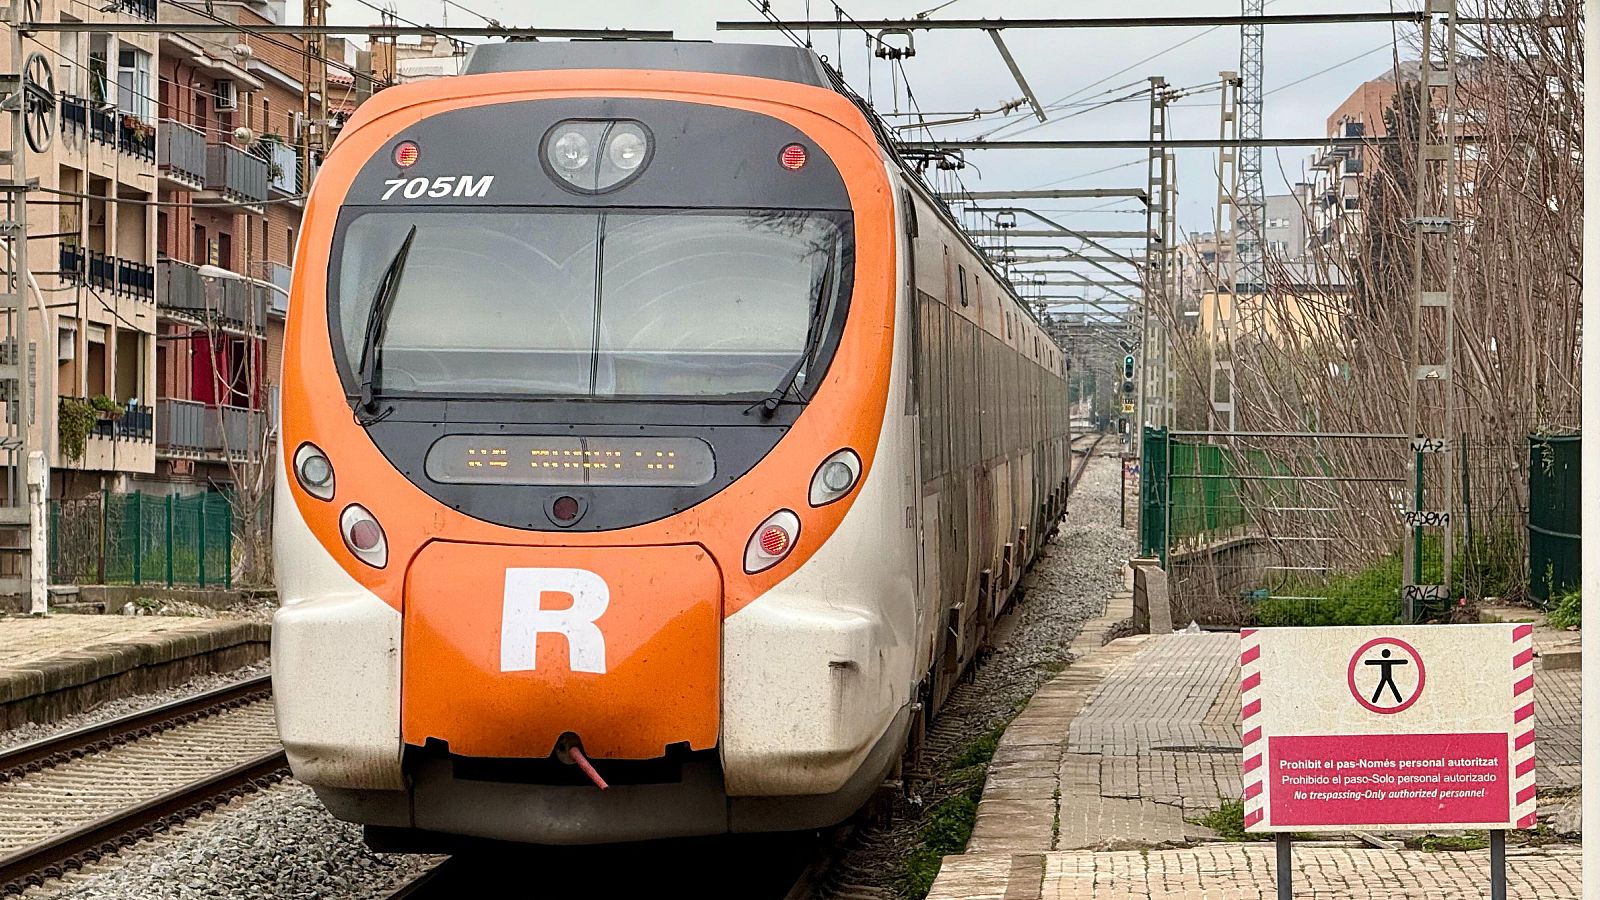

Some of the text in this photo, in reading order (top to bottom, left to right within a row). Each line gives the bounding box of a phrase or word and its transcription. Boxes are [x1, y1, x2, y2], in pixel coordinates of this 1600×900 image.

[381, 175, 495, 201] 705M
[500, 567, 610, 674] R
[1279, 756, 1499, 771] Prohibit el pas-Només personal autoritzat
[1281, 772, 1497, 786] Prohibido el paso-Solo personal autorizado
[1293, 787, 1486, 802] No trespassing-Only authorized personnel
